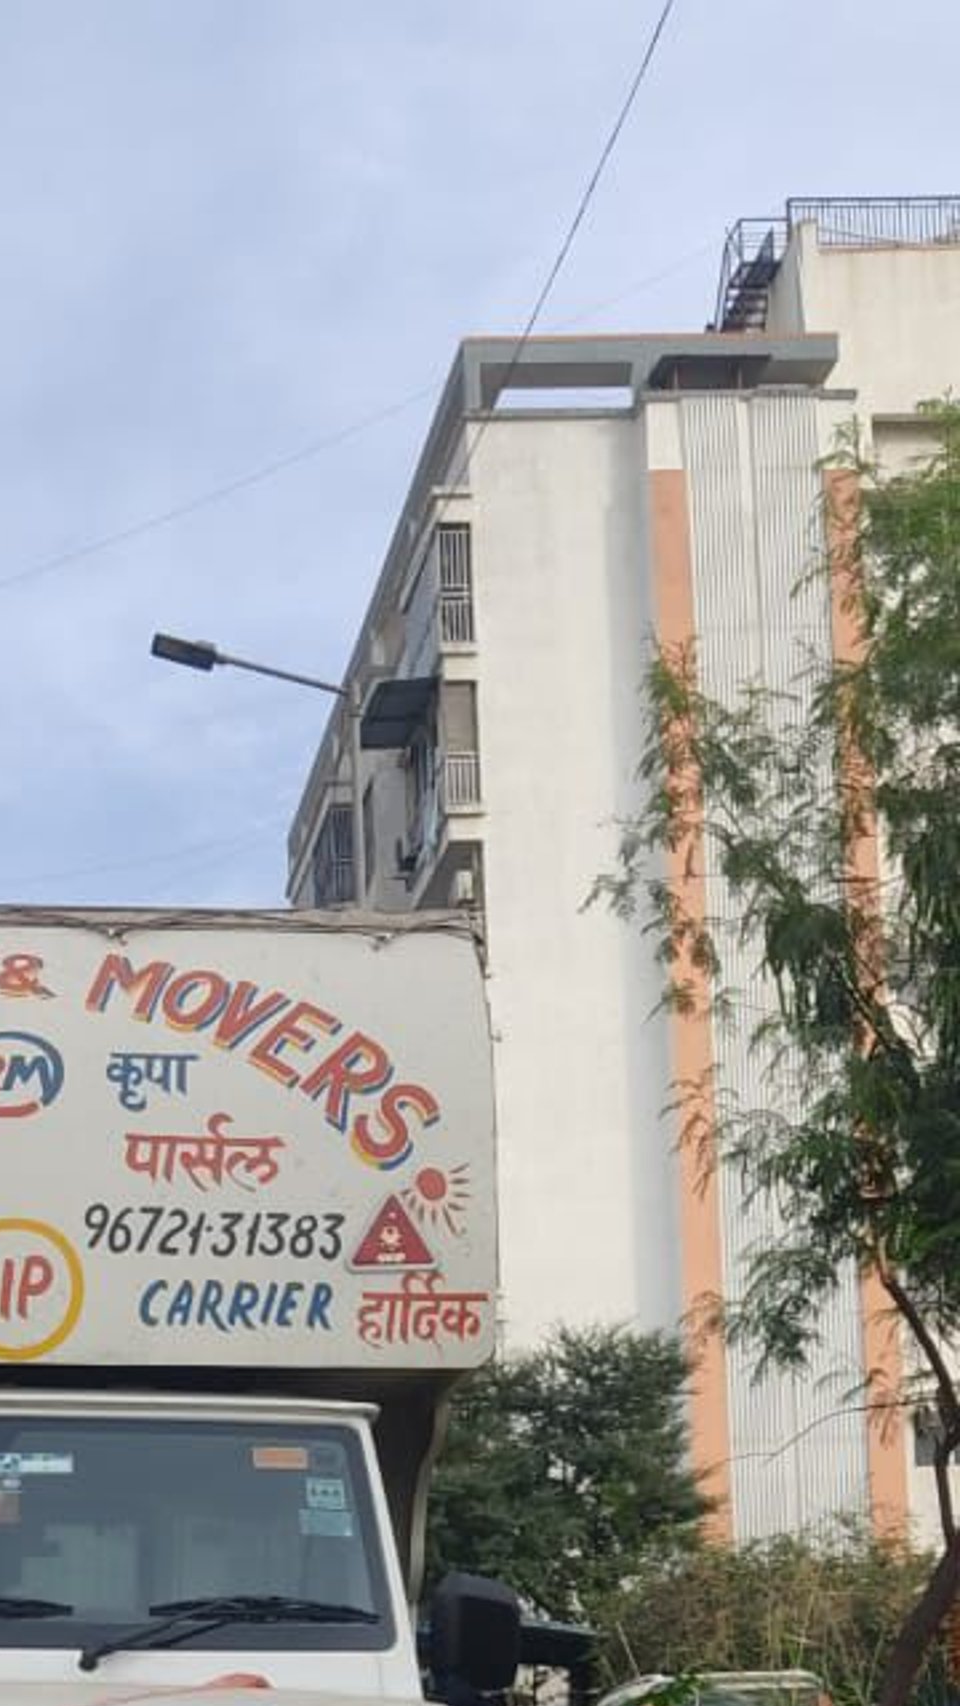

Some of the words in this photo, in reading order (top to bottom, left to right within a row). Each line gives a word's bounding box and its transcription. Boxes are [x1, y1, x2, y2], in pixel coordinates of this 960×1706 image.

[85, 953, 441, 1171] MOVERS
[106, 1052, 201, 1112] कृपा
[124, 1111, 286, 1193] पार्सल
[138, 1278, 335, 1334] CARRIER
[357, 1269, 488, 1352] हार्दिक
